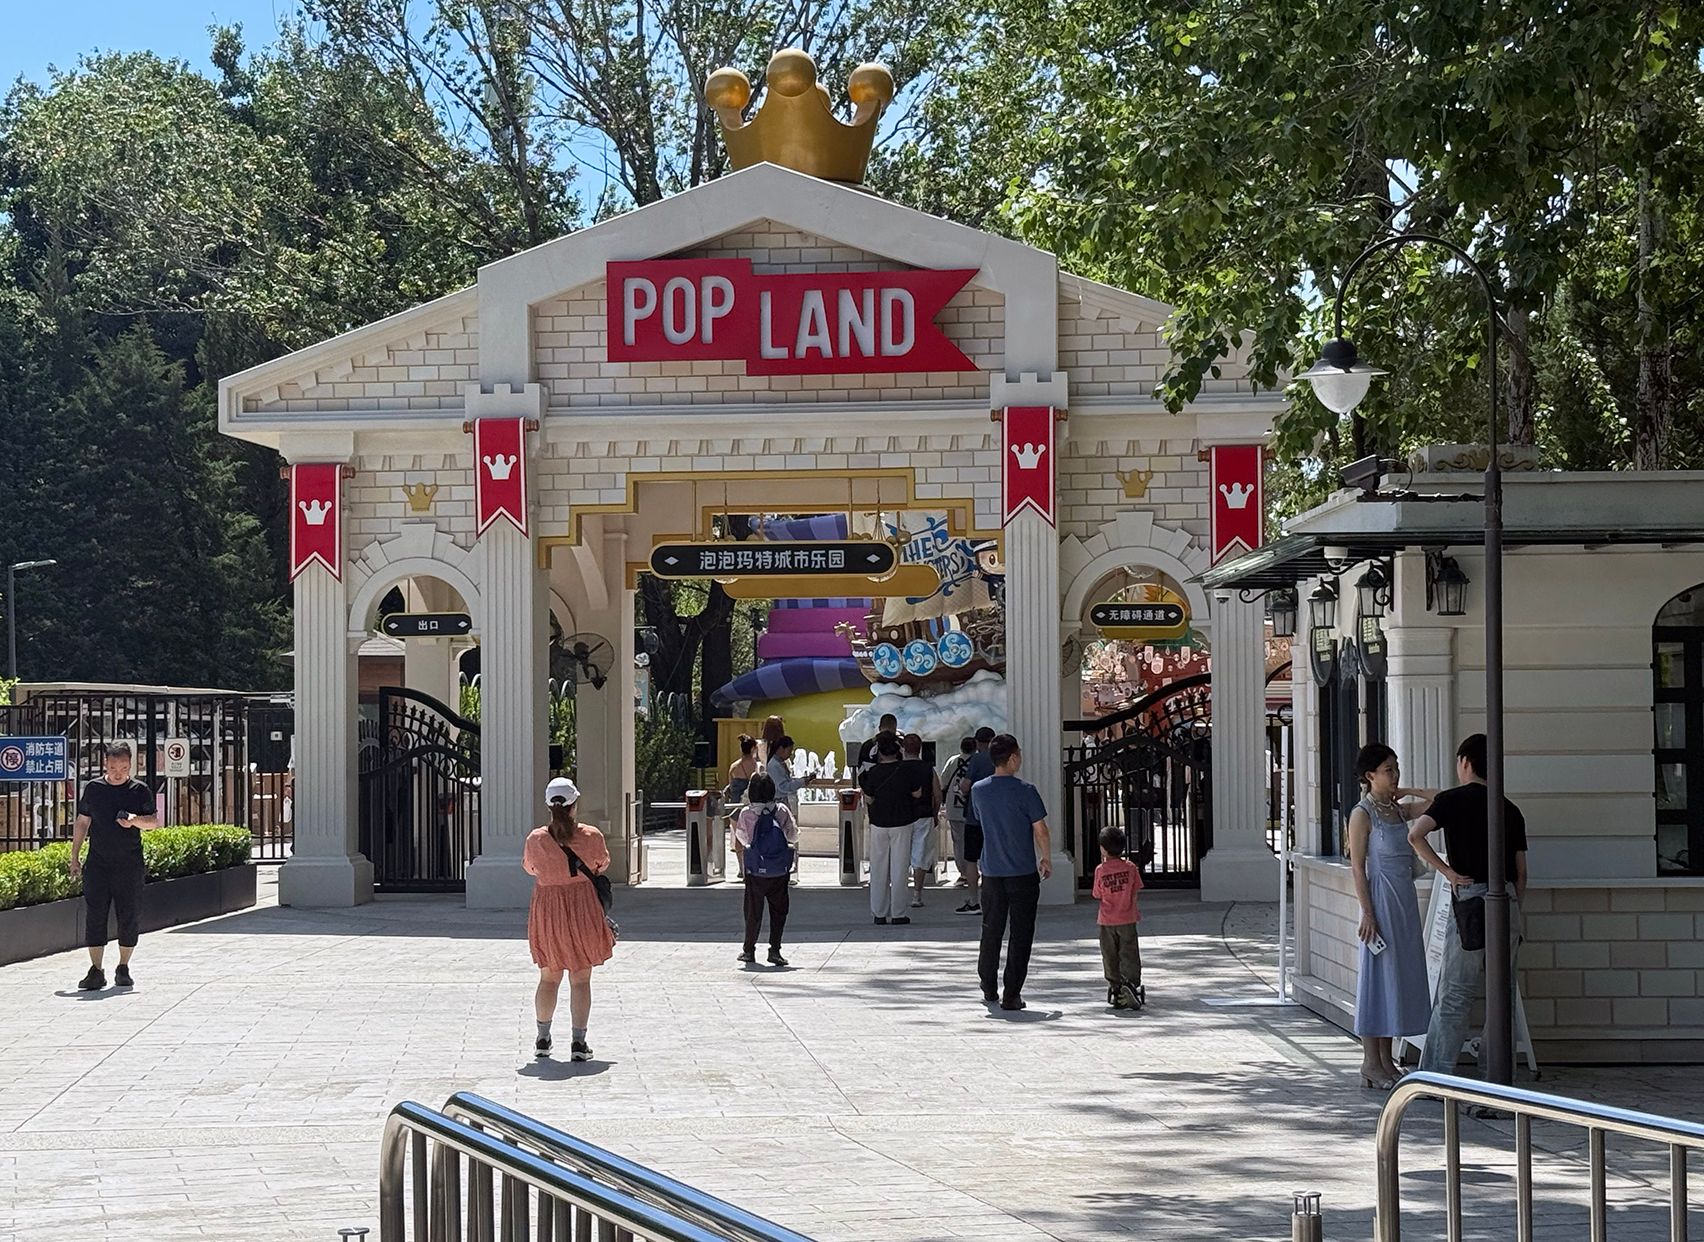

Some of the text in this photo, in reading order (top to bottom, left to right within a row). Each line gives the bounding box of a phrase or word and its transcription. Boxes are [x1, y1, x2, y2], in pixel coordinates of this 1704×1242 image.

[623, 275, 916, 360] POP LAND
[699, 549, 845, 570] 泡泡玛特城市乐园
[1108, 609, 1166, 621] 无障碍通道
[418, 620, 438, 630] 出口
[25, 741, 64, 757] 消防车道
[25, 759, 64, 774] 禁止占用
